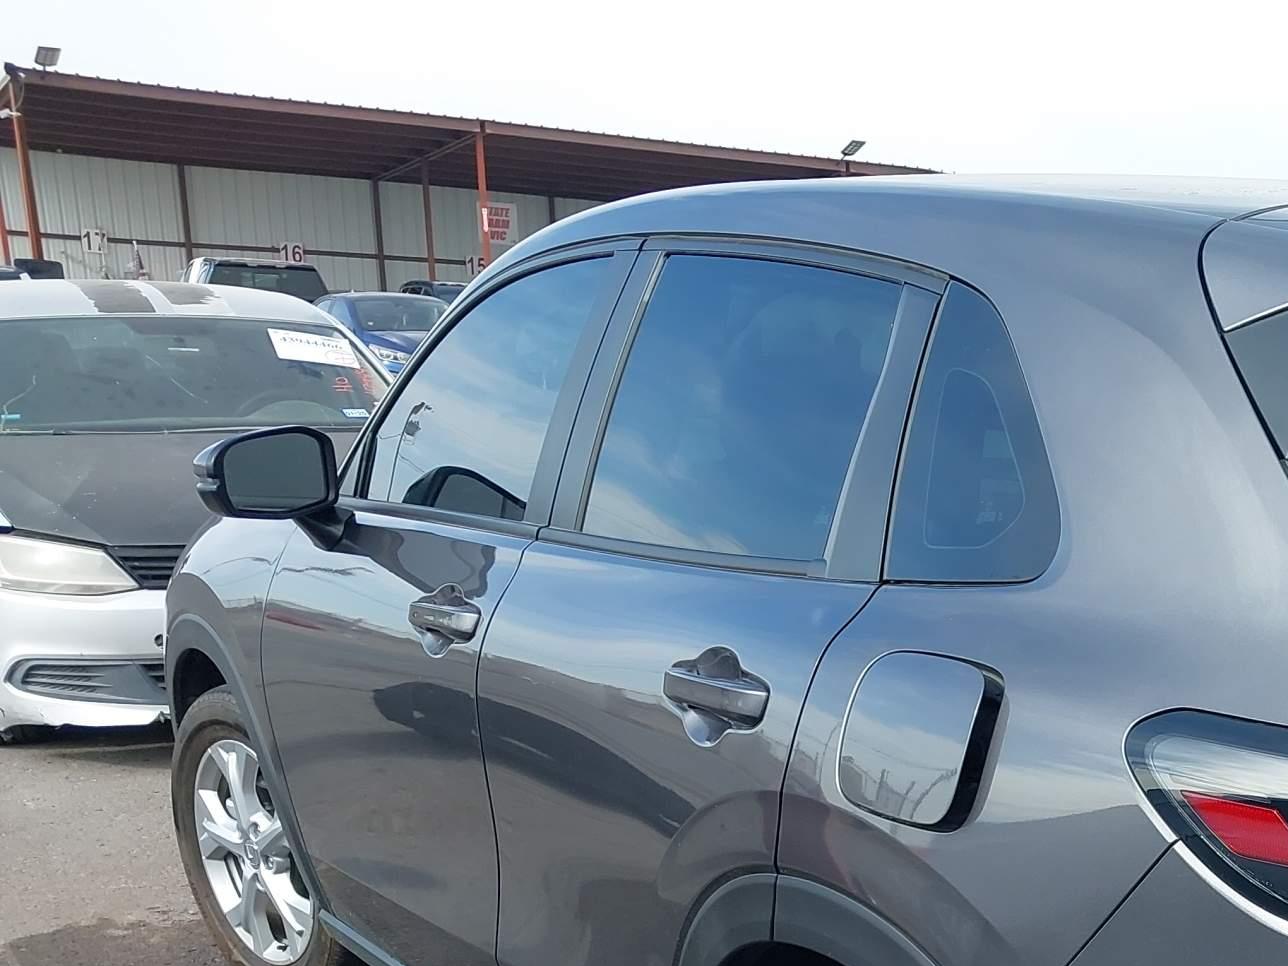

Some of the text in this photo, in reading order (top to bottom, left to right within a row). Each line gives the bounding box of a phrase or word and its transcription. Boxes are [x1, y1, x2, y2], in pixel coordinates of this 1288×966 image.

[487, 207, 511, 218] TATE
[83, 230, 106, 252] 17
[280, 243, 303, 263] 16
[467, 256, 487, 275] 15
